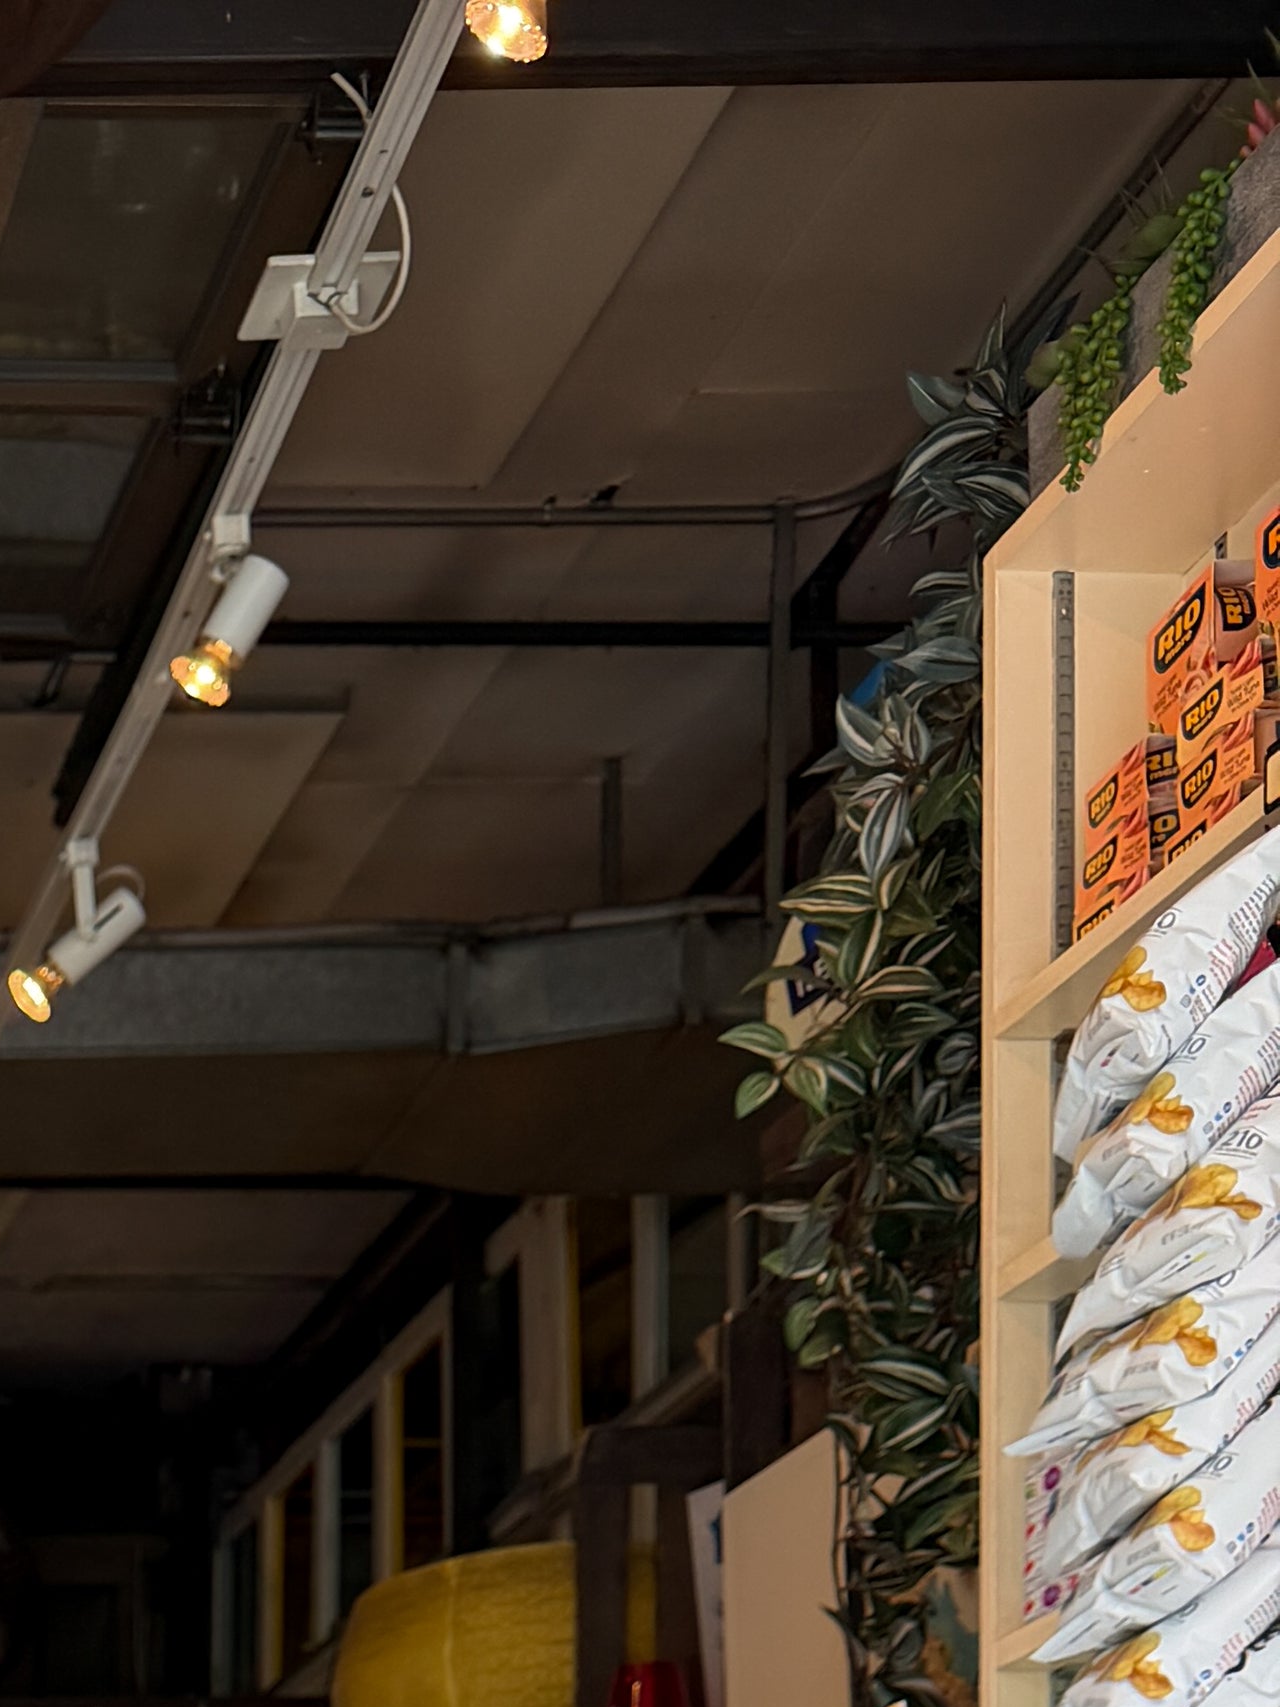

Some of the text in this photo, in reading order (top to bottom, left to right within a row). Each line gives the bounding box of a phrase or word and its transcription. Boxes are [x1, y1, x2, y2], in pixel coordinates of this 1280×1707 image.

[1157, 598, 1201, 661] RIO
[1184, 688, 1220, 732] RIO
[1184, 759, 1214, 800] RIO
[1090, 782, 1115, 819] RIO
[1085, 843, 1114, 879] RIO
[1221, 1130, 1263, 1150] 210
